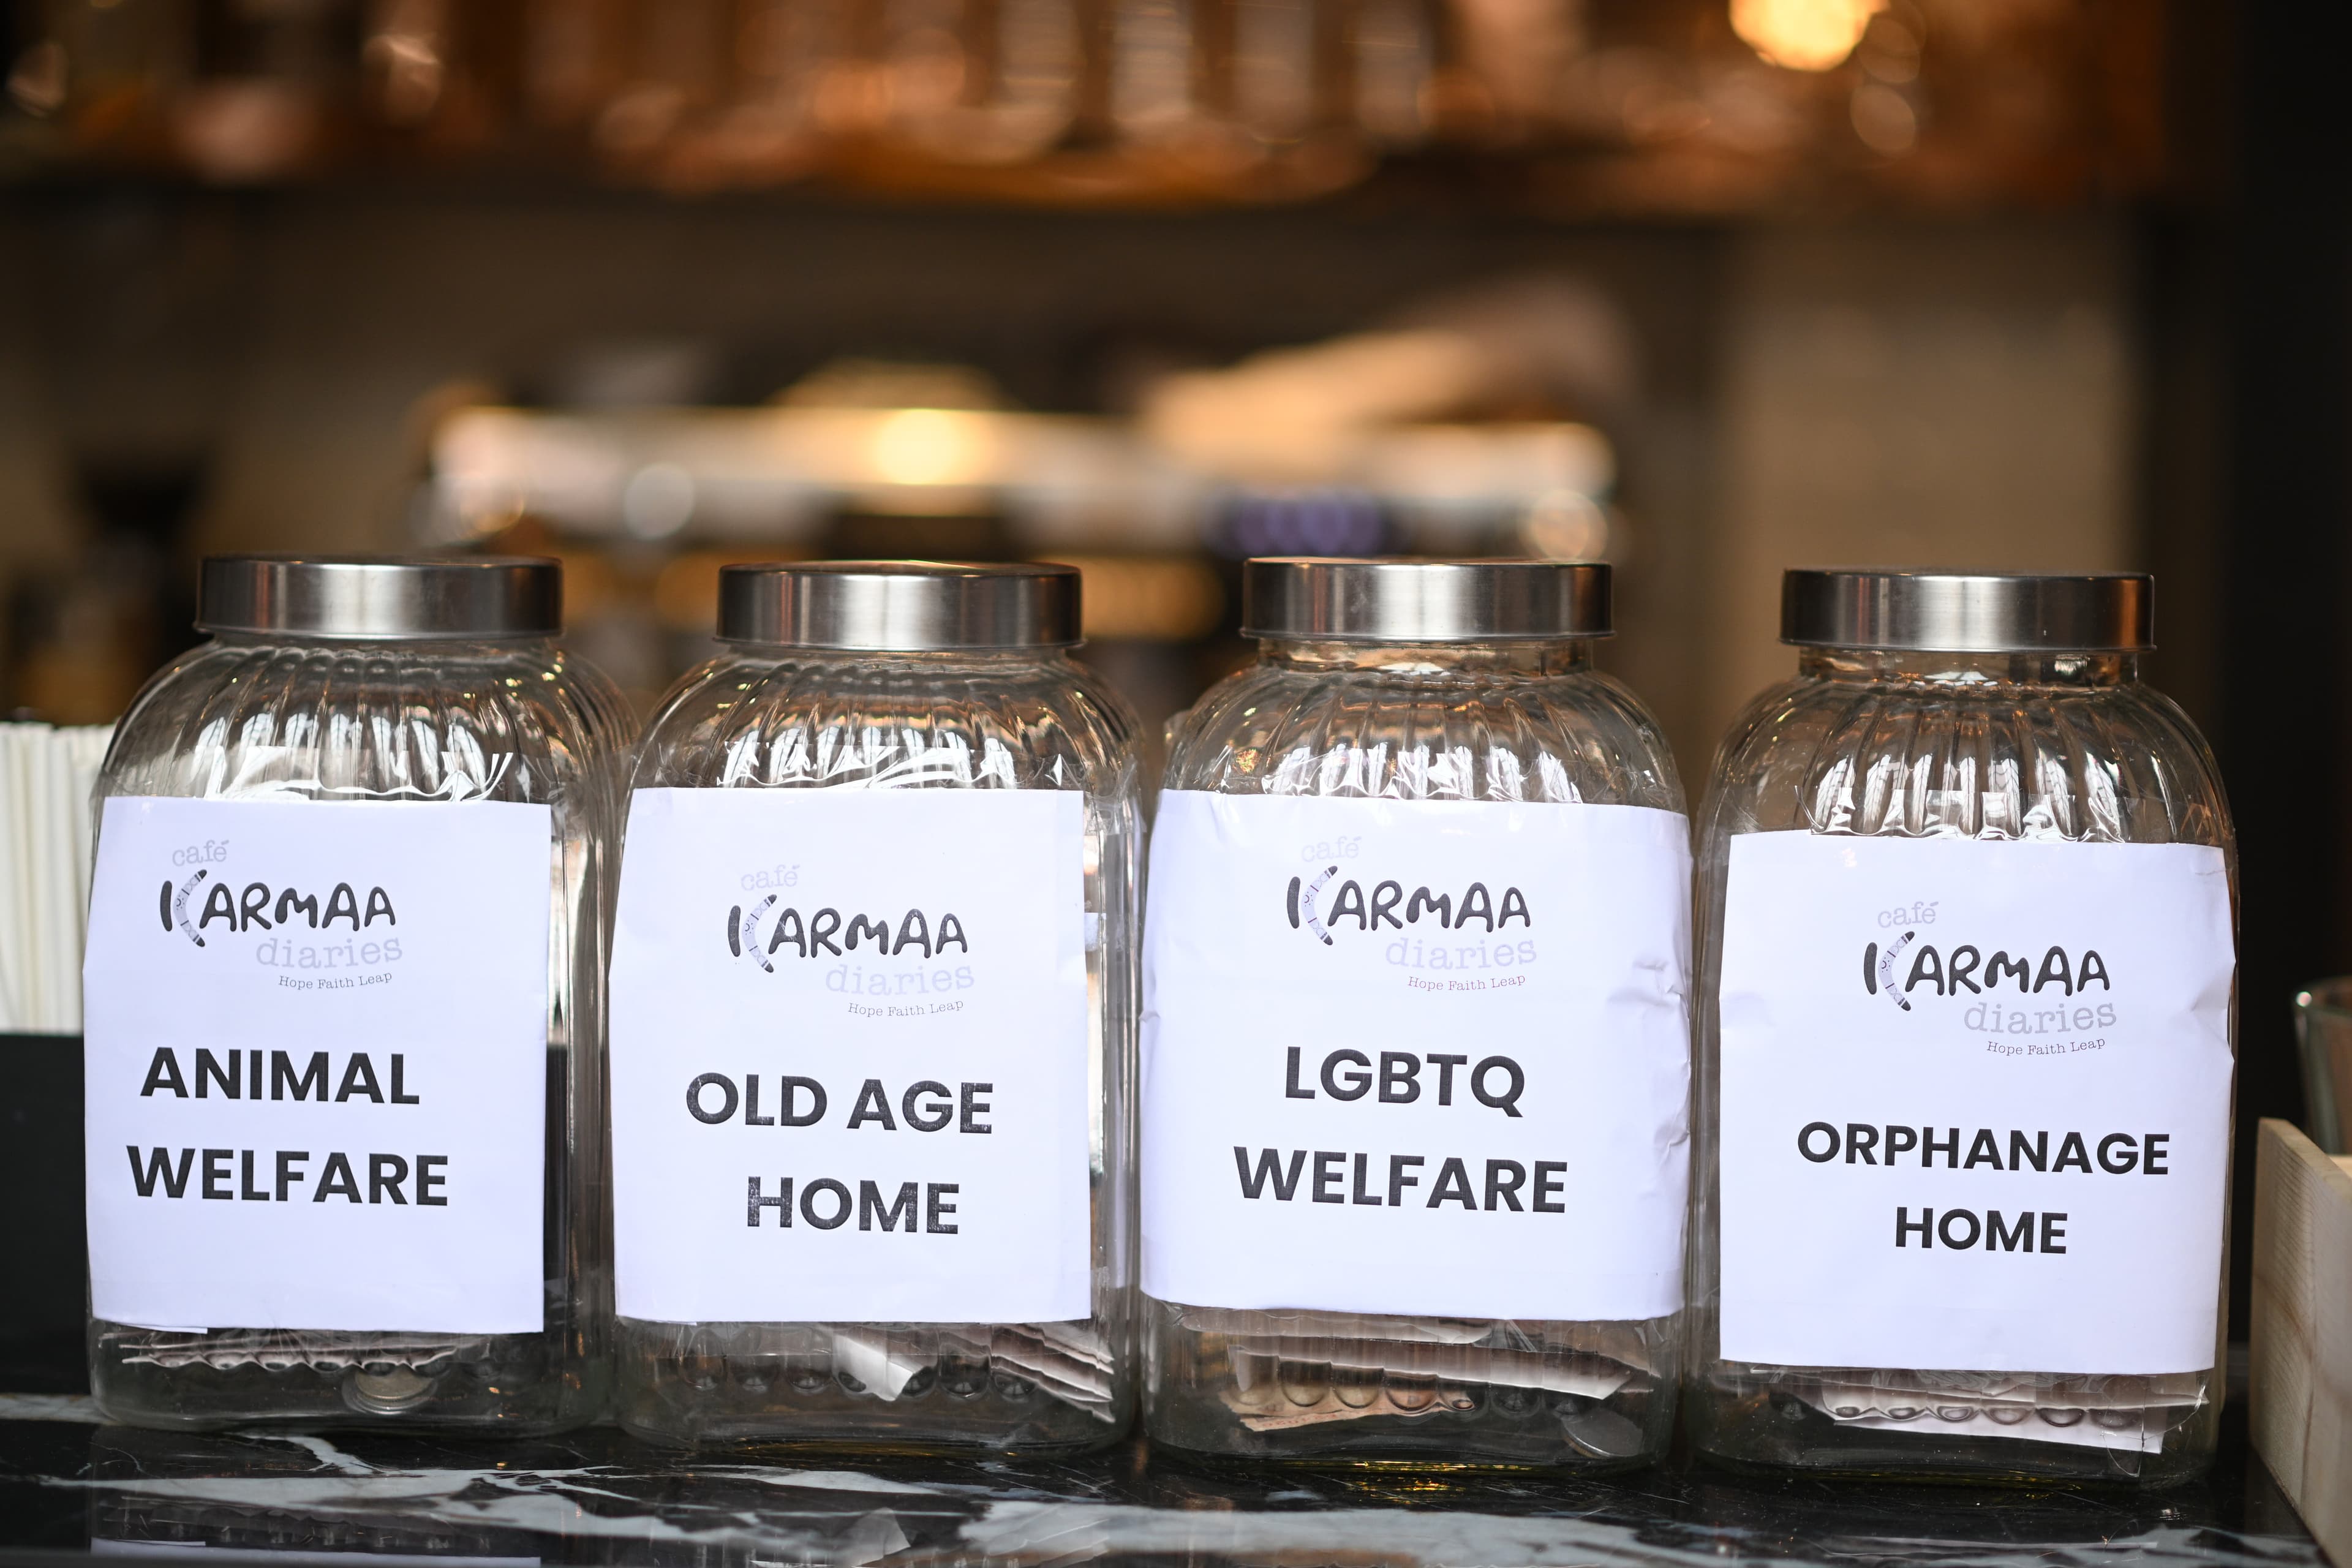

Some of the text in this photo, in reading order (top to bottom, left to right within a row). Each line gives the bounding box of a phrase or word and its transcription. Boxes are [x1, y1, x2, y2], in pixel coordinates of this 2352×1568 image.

[171, 839, 230, 868] café
[1302, 835, 1363, 864] café
[740, 864, 801, 892] café
[159, 869, 397, 948] KARMAA
[1286, 865, 1532, 947] KARMAA
[1876, 900, 1940, 929] café
[255, 936, 404, 970] diaries
[726, 894, 968, 974] KARMAA
[1385, 936, 1538, 971] diaries
[277, 971, 393, 992] Hope Faith Leap
[824, 963, 976, 997] diaries
[1407, 974, 1526, 992] Hope Faith Leap
[1863, 930, 2111, 1012] KARMAA
[847, 999, 964, 1019] Hope Faith Leap
[1963, 1000, 2118, 1036] diaries
[1986, 1037, 2106, 1057] Hope Faith Leap
[139, 1046, 420, 1106] ANIMAL
[1284, 1046, 1526, 1118] LGBTQ
[685, 1071, 994, 1135] OLD AGE
[1796, 1120, 2171, 1176] ORPHANAGE
[125, 1144, 449, 1207] WELFARE
[1232, 1145, 1569, 1215] WELFARE
[746, 1175, 960, 1235] HOME
[1894, 1205, 2068, 1255] HOME
